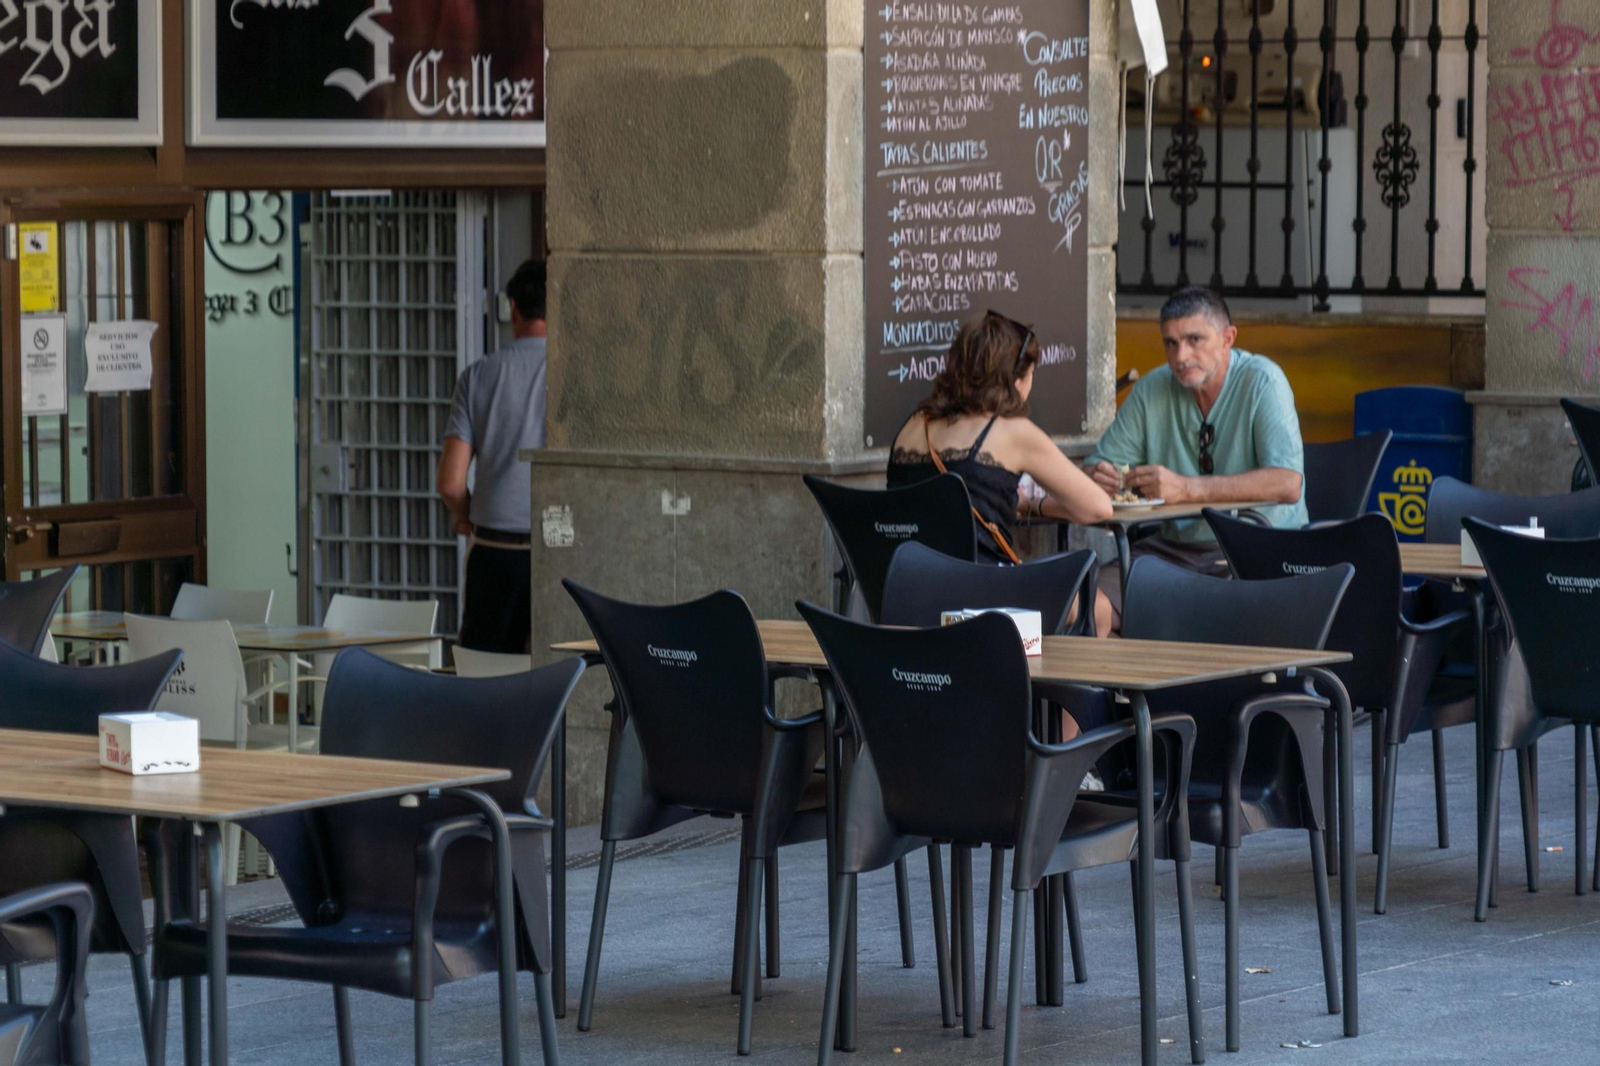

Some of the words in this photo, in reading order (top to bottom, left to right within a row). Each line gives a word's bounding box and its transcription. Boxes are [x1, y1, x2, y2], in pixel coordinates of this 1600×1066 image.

[949, 30, 964, 48] DE
[968, 28, 1014, 46] MARISCO
[1023, 30, 1090, 66] CONSULTE
[406, 49, 536, 117] Calles
[960, 73, 976, 92] EN
[979, 72, 1024, 96] VINAGRE
[1034, 67, 1084, 98] PRECIOS
[918, 117, 932, 132] AL
[935, 115, 968, 131] AJILLO
[1018, 103, 1034, 130] EN
[1038, 102, 1089, 127] NUESTRO
[880, 141, 920, 168] TAPAS
[922, 139, 989, 165] CALIENTES
[899, 174, 930, 197] ATÚN
[934, 175, 957, 194] CON
[960, 171, 1004, 193] TOMATE
[899, 199, 956, 221] ESPINACAS
[957, 199, 975, 217] CON
[976, 196, 1037, 219] GARBANZOS
[930, 222, 1001, 246] ENCEBOLLADO
[900, 248, 939, 273] PISTO
[941, 248, 963, 272] CON
[967, 249, 998, 268] HUEVO
[901, 273, 942, 292] HABAS
[900, 291, 971, 314] CARACOLES
[883, 318, 960, 348] MONTADITOS
[647, 643, 698, 663] Cruzcampo
[892, 667, 952, 687] Cruzcampo
